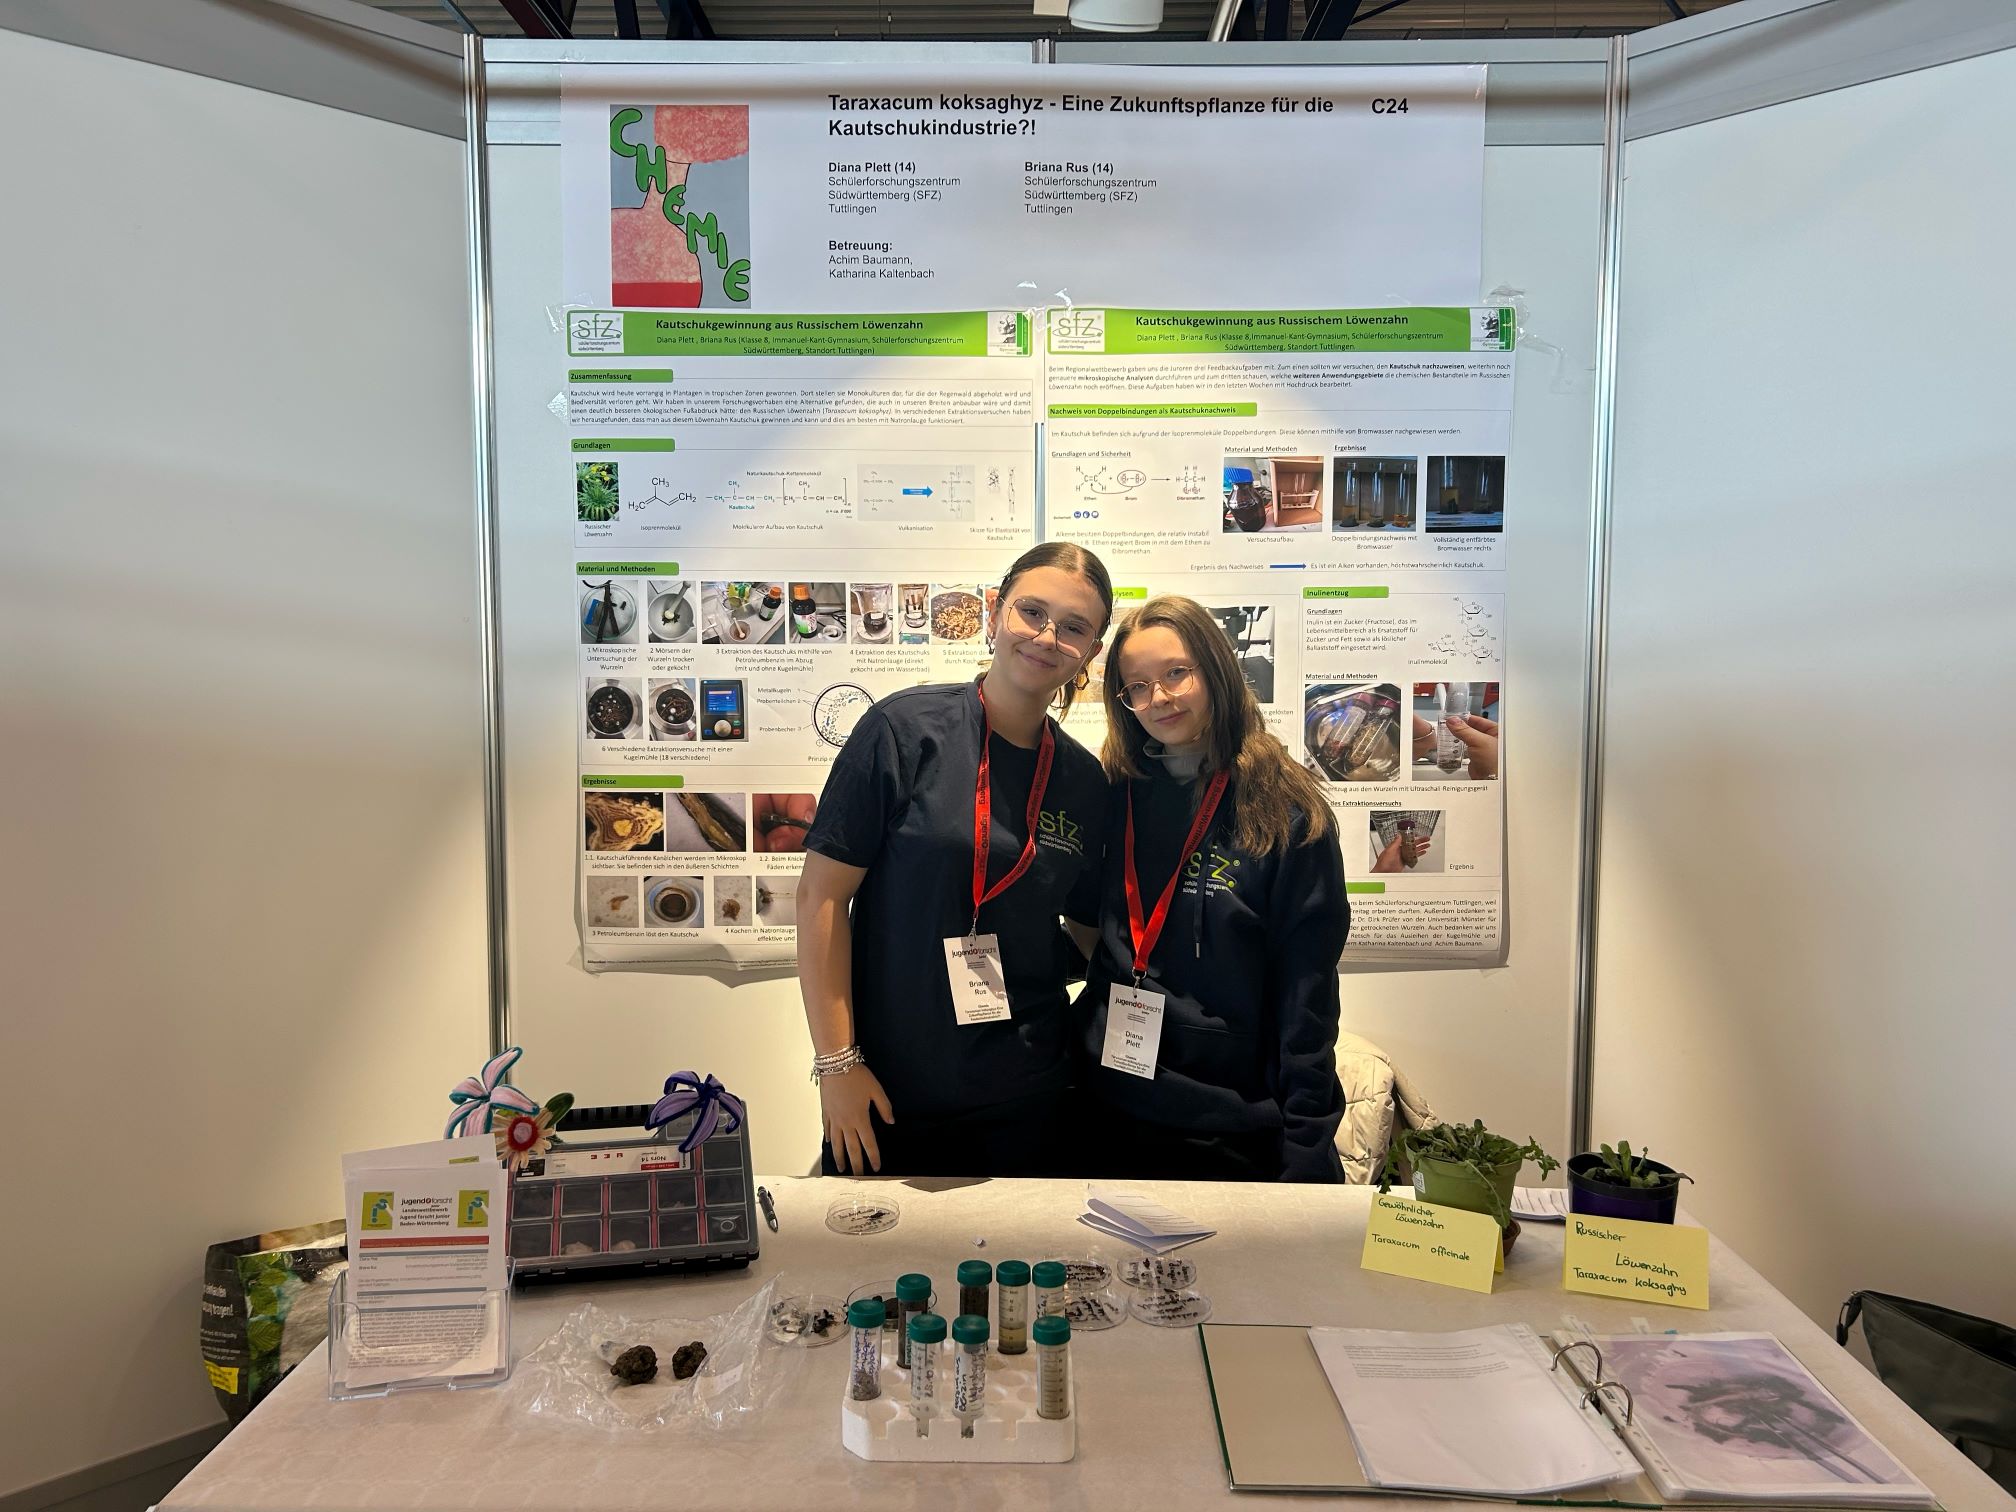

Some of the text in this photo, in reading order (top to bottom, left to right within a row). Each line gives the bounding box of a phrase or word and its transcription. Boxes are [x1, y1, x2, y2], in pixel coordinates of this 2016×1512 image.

[828, 95, 932, 110] Taraxacum
[940, 94, 1043, 114] koksaghyz
[1062, 95, 1103, 111] Eine
[1109, 96, 1265, 117] Zukunftspflanze
[1271, 96, 1298, 112] für
[1304, 96, 1333, 112] die
[1371, 98, 1408, 113] C24
[829, 119, 1035, 135] Kautschukindustrie?!
[828, 162, 915, 174] Diana Plett (14)
[1024, 161, 1113, 175] Briana Rus (14)
[828, 176, 960, 188] Schülerforschungszentrum
[1024, 175, 1156, 189] Schülerforschungszentrum
[828, 189, 941, 201] Südwürttemberg (SFZ)
[1024, 189, 1137, 202] Südwürttemberg (SFZ)
[609, 108, 751, 303] CHEMIE
[828, 203, 876, 215] Tuttlingen
[1024, 203, 1072, 215] Tuttlingen
[829, 240, 892, 252] Betreuung:
[828, 254, 912, 265] Achim Baumann,
[829, 268, 934, 278] Katharina Kaltenbach
[656, 319, 923, 331] Kautschukgewinnung aus Russischem Löwenzahn
[1136, 315, 1408, 327] Kautschukgewinnung aus Russischem Löwenzahn
[656, 335, 676, 343] Diana
[700, 335, 722, 343] Briana
[723, 335, 736, 343] Rus
[738, 335, 762, 343] (Klasse
[772, 336, 870, 344] Immanuel-Kant-Gymnasium,
[872, 336, 963, 345] Schülerforschungszentrum
[1136, 333, 1156, 341] Diana
[1180, 333, 1202, 342] Briana
[1204, 332, 1217, 340] Rus
[1218, 333, 1243, 341] (Klasse
[1351, 331, 1443, 340] Schülerforschungszentrum
[743, 346, 874, 356] Südwürttemberg, Standort Tuttlingen)
[569, 372, 631, 381] Zusammenfassung
[1077, 374, 1155, 382] mikroskopische Analysen
[1321, 371, 1385, 379] Anwendungsgebiete
[1049, 406, 1082, 414] Nachweis
[1097, 407, 1157, 415] Doppelbindungen
[1158, 407, 1168, 415] als
[1169, 406, 1235, 415] Kautschuknachweis
[573, 441, 610, 449] Grundlagen
[1224, 445, 1297, 453] Material und Methoden
[1334, 444, 1366, 452] Ergebnisse
[1051, 449, 1131, 458] Grundlagen und Sicherheit
[578, 564, 655, 572] Material und Methoden
[1307, 589, 1348, 598] Inulinentzug
[1306, 607, 1342, 615] Grundlagen
[600, 663, 623, 671] Wurzeln
[667, 663, 689, 671] gekocht
[1305, 672, 1377, 680] Material und Methoden
[583, 778, 616, 786] Ergebnisse
[1328, 799, 1401, 807] des Extraktionsversuchs
[1449, 862, 1473, 870] Ergebnis
[1115, 997, 1137, 1007] jugend
[1126, 1031, 1143, 1040] Diana
[1126, 1040, 1140, 1048] Plett
[401, 1197, 425, 1205] jugend
[1378, 1198, 1435, 1217] Gewöhnlicher
[1395, 1211, 1445, 1231] Löwenzahn
[1576, 1221, 1625, 1242] Russischer
[1371, 1234, 1470, 1261] Taraxacum officinale
[1616, 1253, 1679, 1278] Löwenzahn
[1573, 1267, 1627, 1284] Taraxacum
